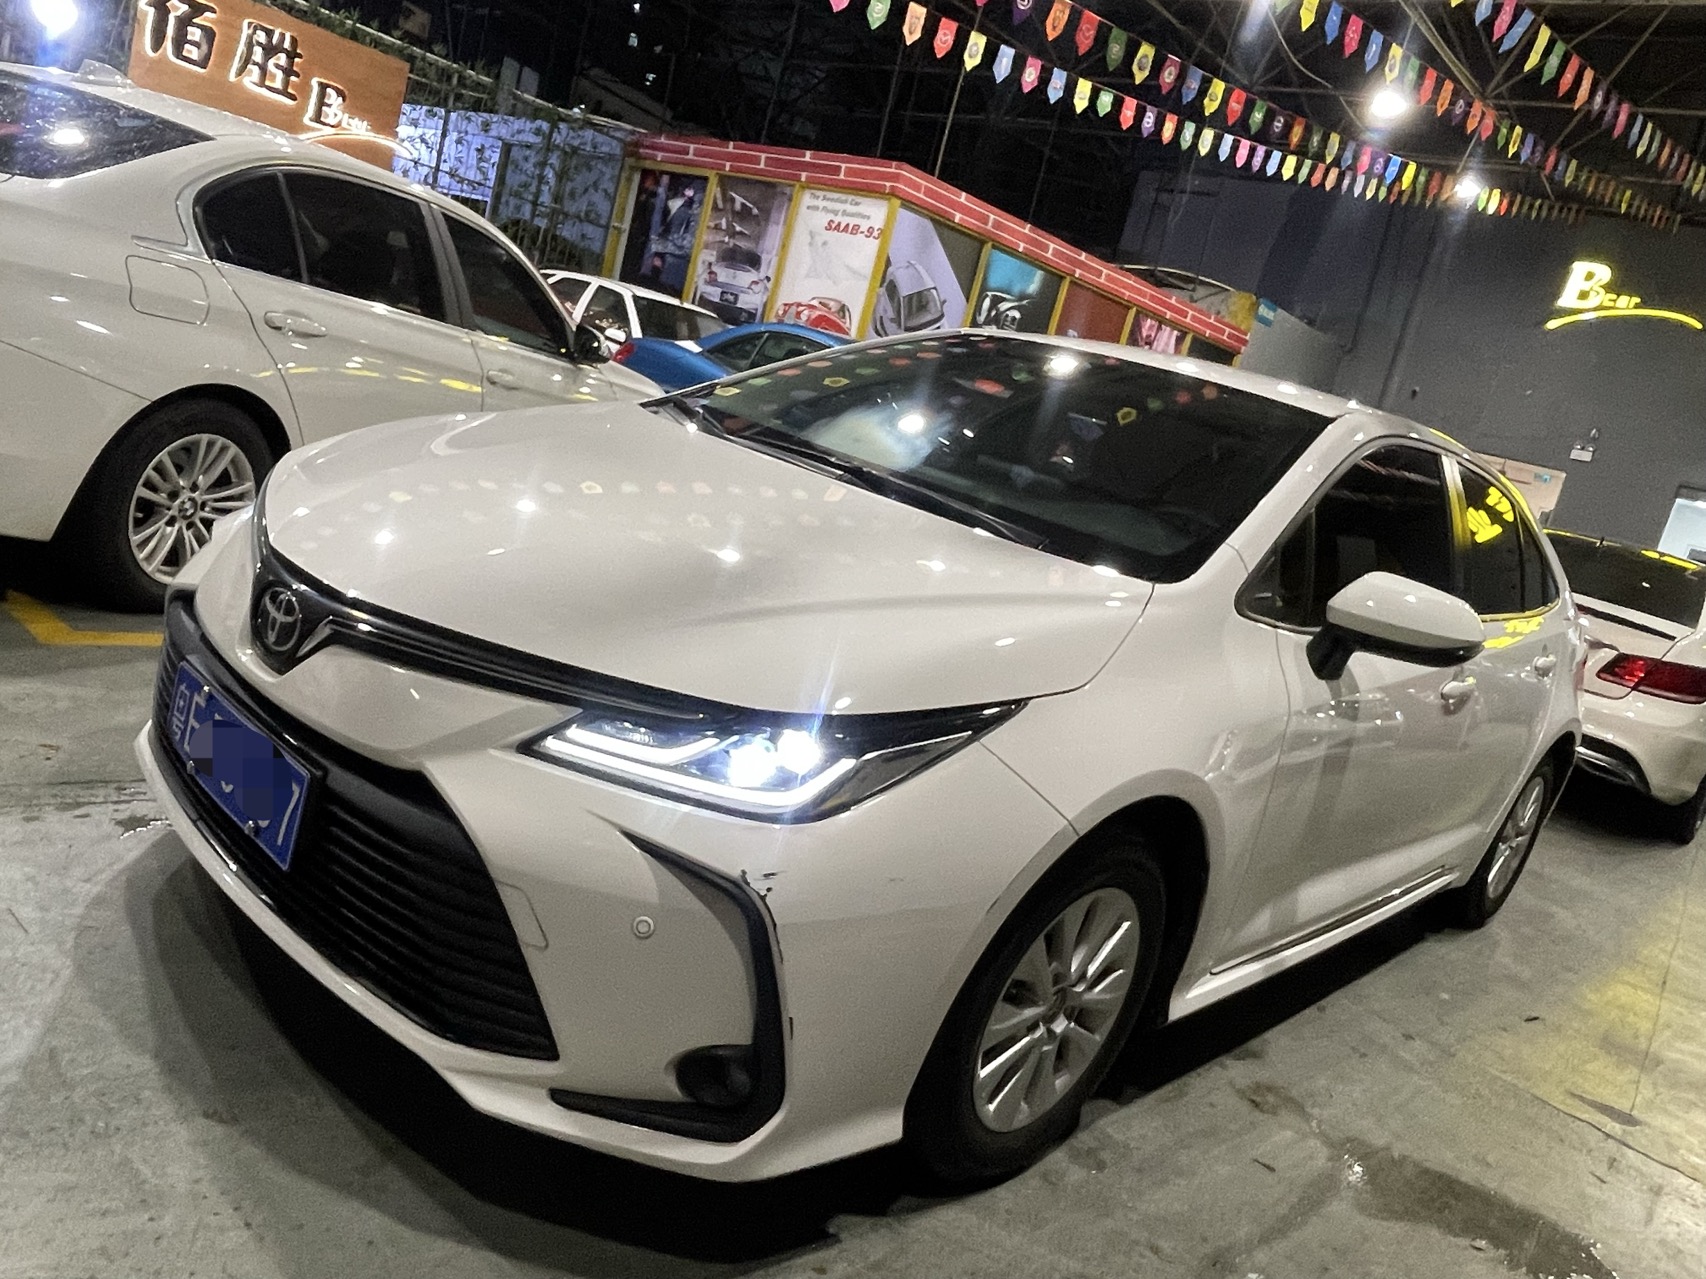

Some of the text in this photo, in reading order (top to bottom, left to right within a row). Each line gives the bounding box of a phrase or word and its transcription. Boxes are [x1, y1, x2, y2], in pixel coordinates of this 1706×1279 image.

[138, 0, 304, 105] 佰胜
[809, 192, 862, 207] The Swedish Car
[806, 204, 820, 212] with
[820, 205, 840, 217] Flying
[824, 219, 883, 241] SAAB-93
